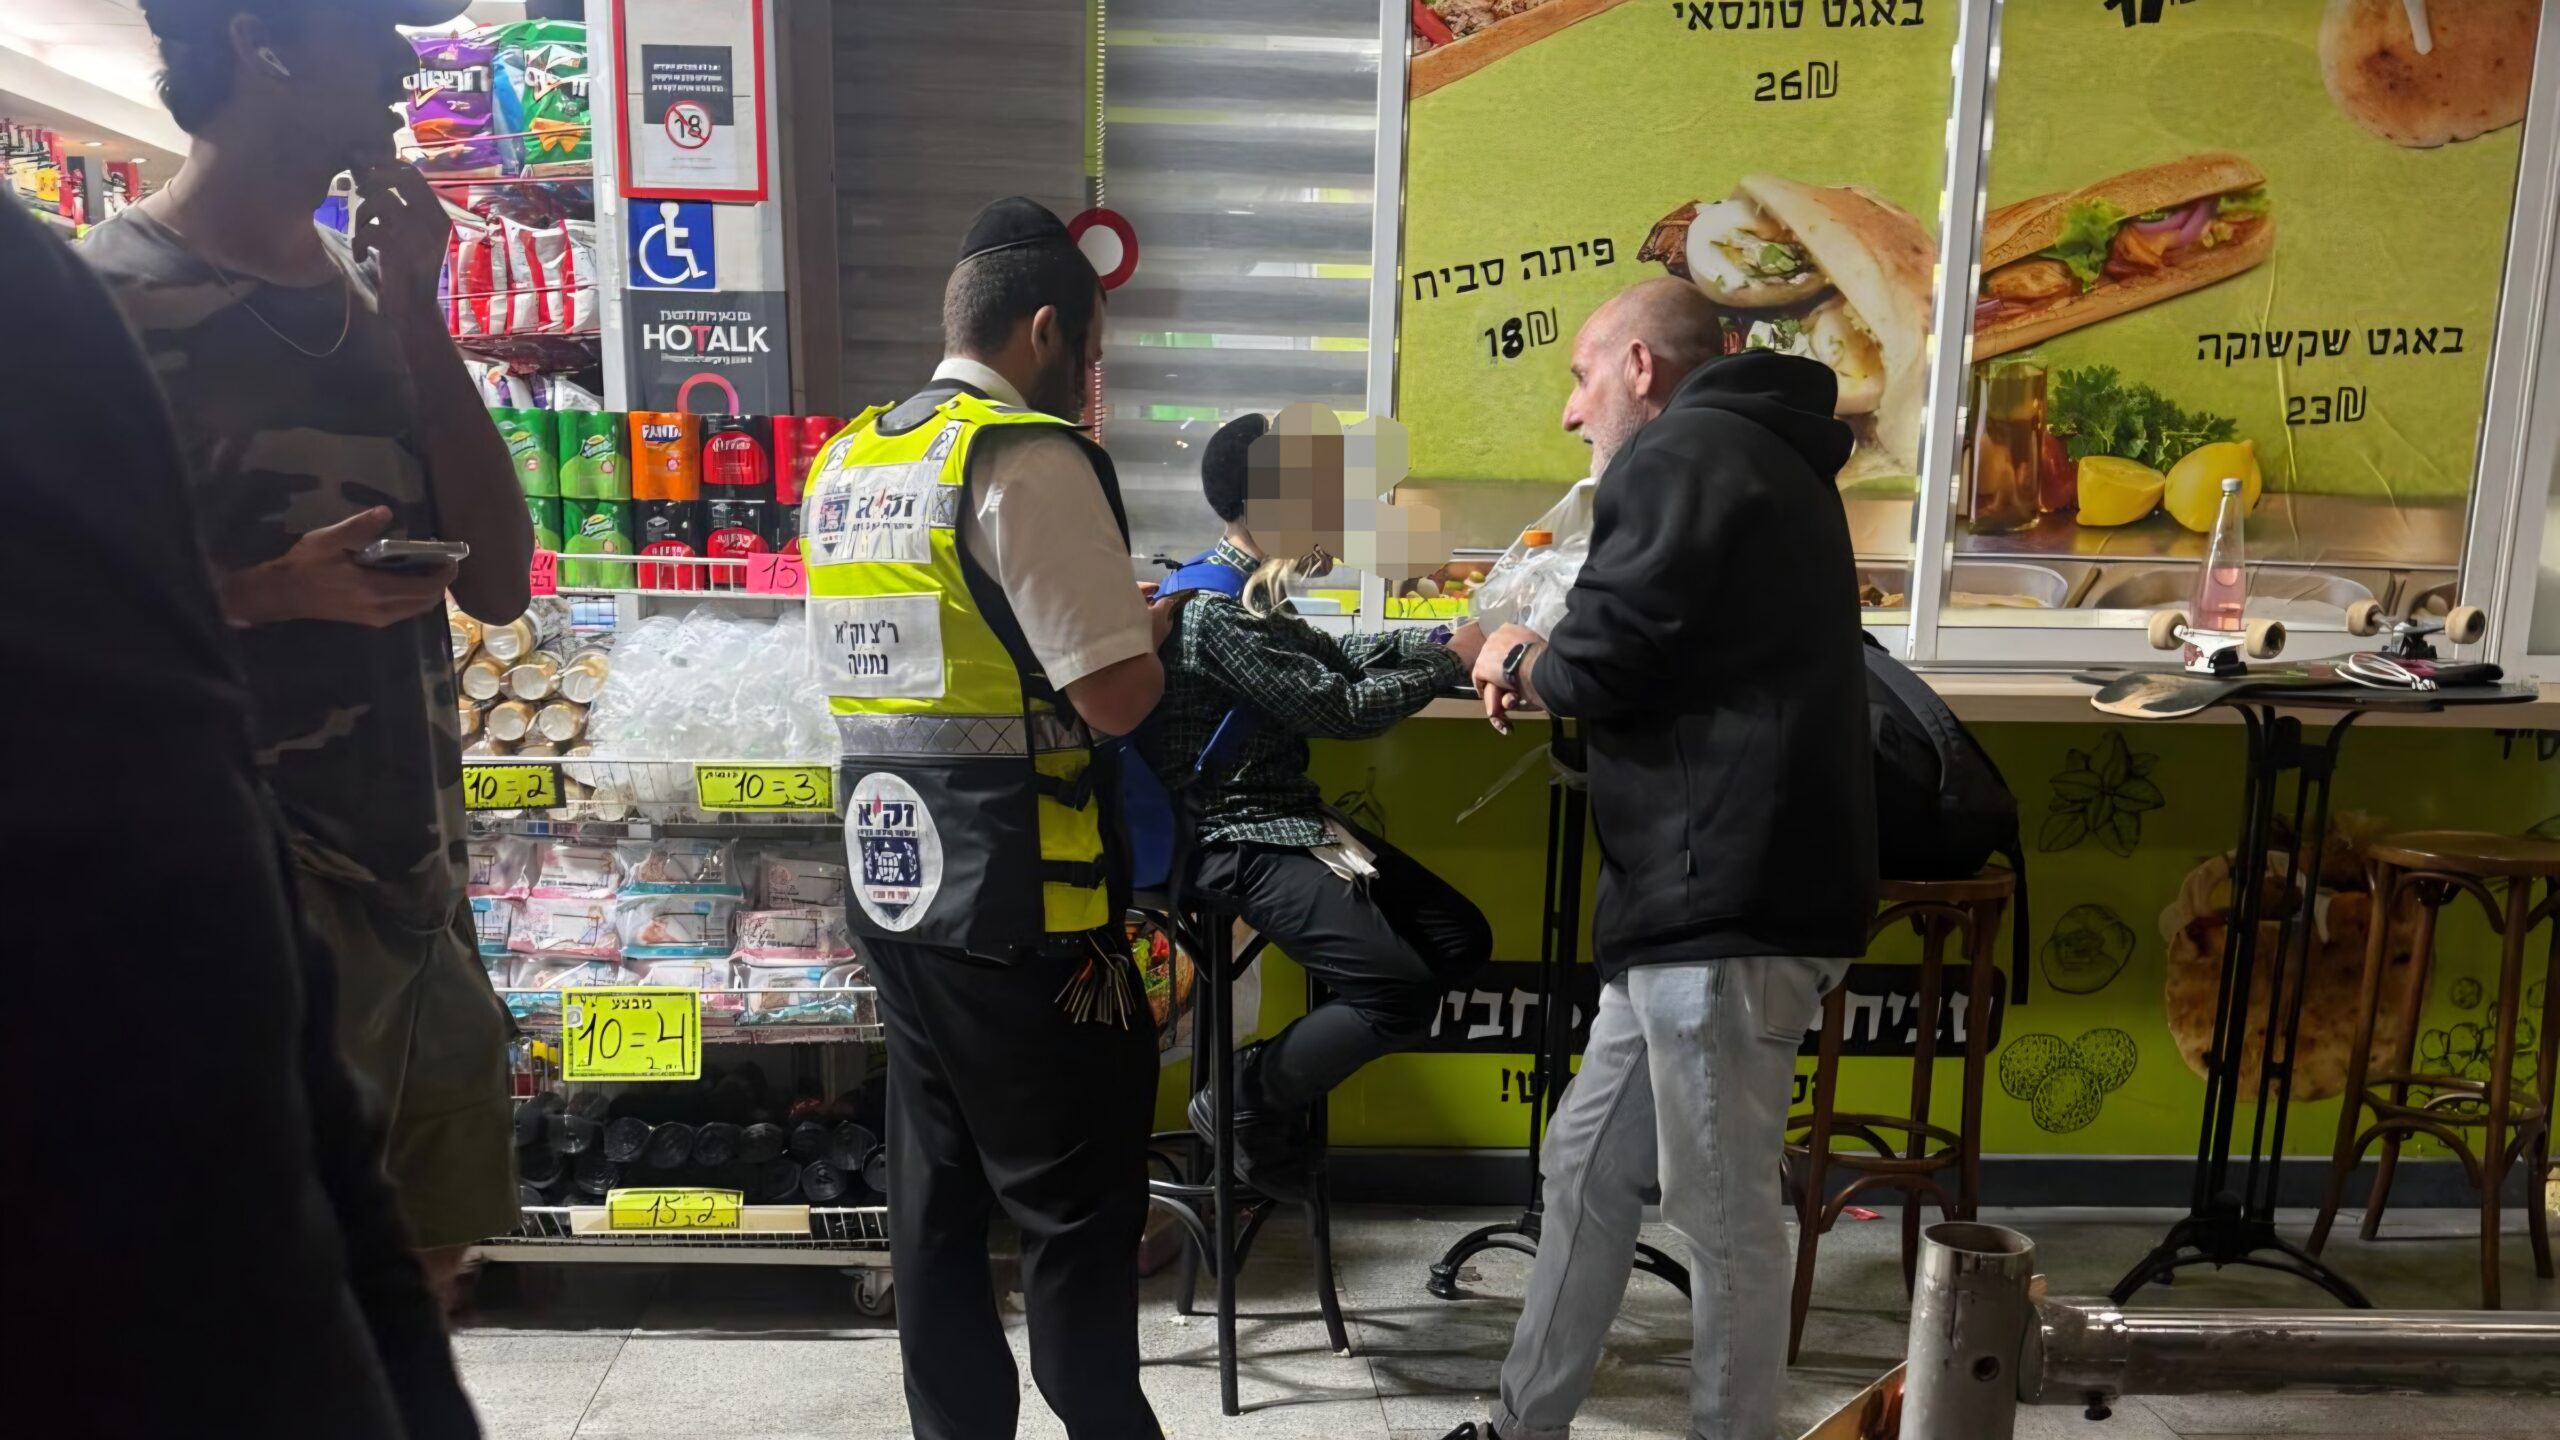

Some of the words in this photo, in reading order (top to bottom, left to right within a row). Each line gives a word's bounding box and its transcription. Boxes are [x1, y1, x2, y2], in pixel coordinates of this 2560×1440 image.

[1521, 237, 1615, 282] פיתה
[1412, 257, 1504, 301] סביח
[643, 323, 771, 354] HOTALK
[2197, 328, 2351, 367] שקשוקה
[2367, 326, 2465, 355] באגט
[848, 653, 888, 675] נתניה
[611, 998, 652, 1010] מבצע
